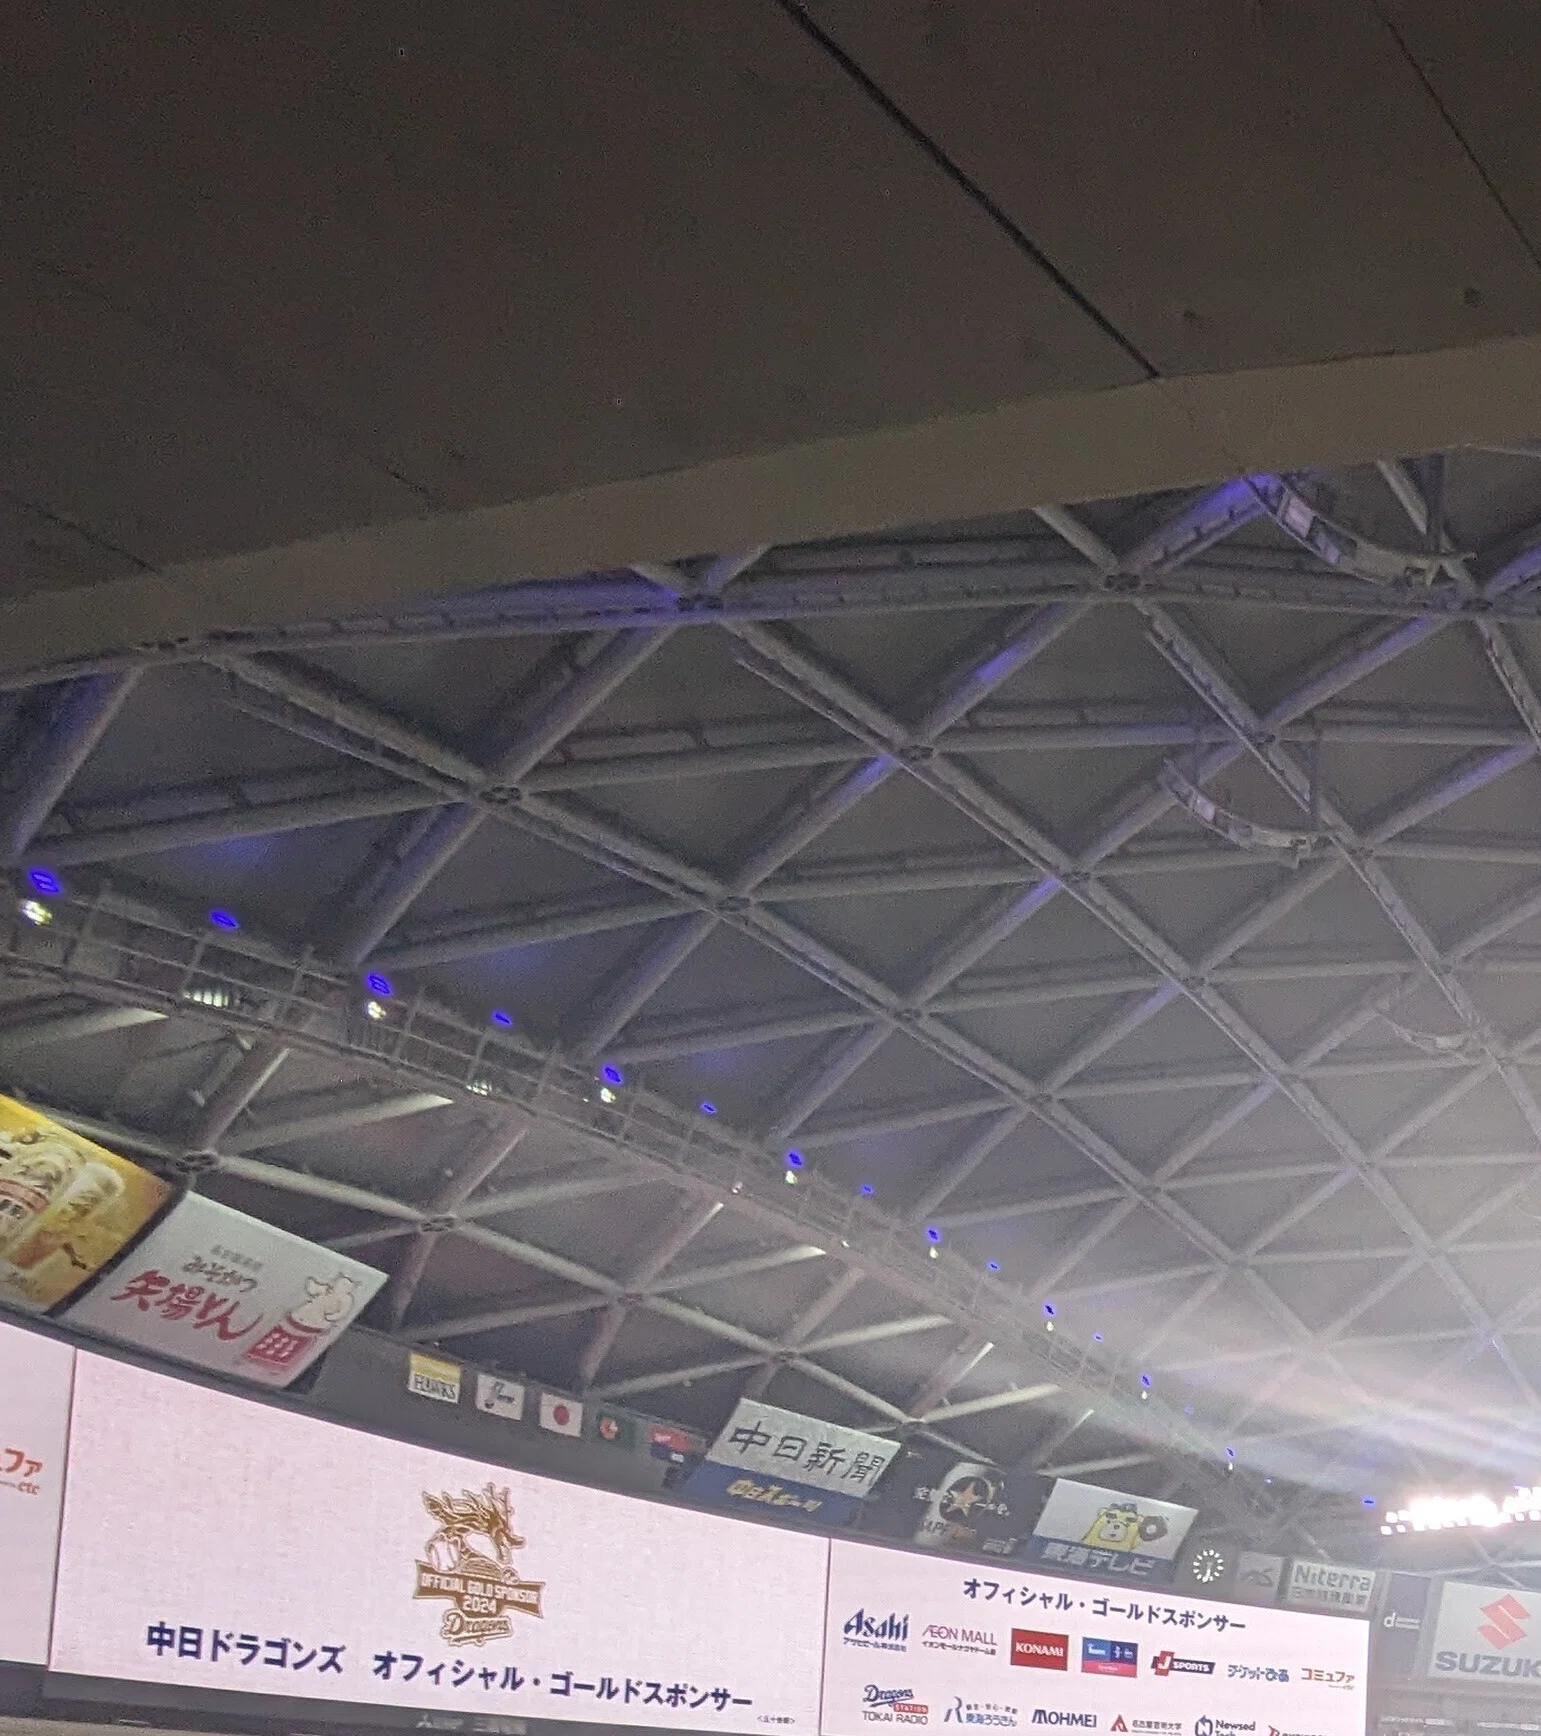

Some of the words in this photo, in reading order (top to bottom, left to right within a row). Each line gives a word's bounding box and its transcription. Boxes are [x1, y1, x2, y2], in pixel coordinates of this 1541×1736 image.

[728, 1421, 886, 1483] 中日新聞
[1293, 1564, 1372, 1593] Niterra
[462, 1594, 497, 1614] 2024
[963, 1577, 1246, 1633] オフィシャル・ゴールドスポンサー
[843, 1608, 910, 1641] Asahi
[962, 1629, 998, 1646] MALL
[1015, 1642, 1064, 1657] KONAMI
[146, 1621, 347, 1674] 中日ドラゴンズ
[372, 1650, 753, 1712] オフィシャル・ゴールドスポンサー
[1173, 1661, 1211, 1673] SPORTS
[1227, 1664, 1290, 1683] チケットぴあ
[1301, 1667, 1355, 1684] コミュファ
[862, 1710, 893, 1722] TOKAI
[896, 1713, 928, 1725] RADIO
